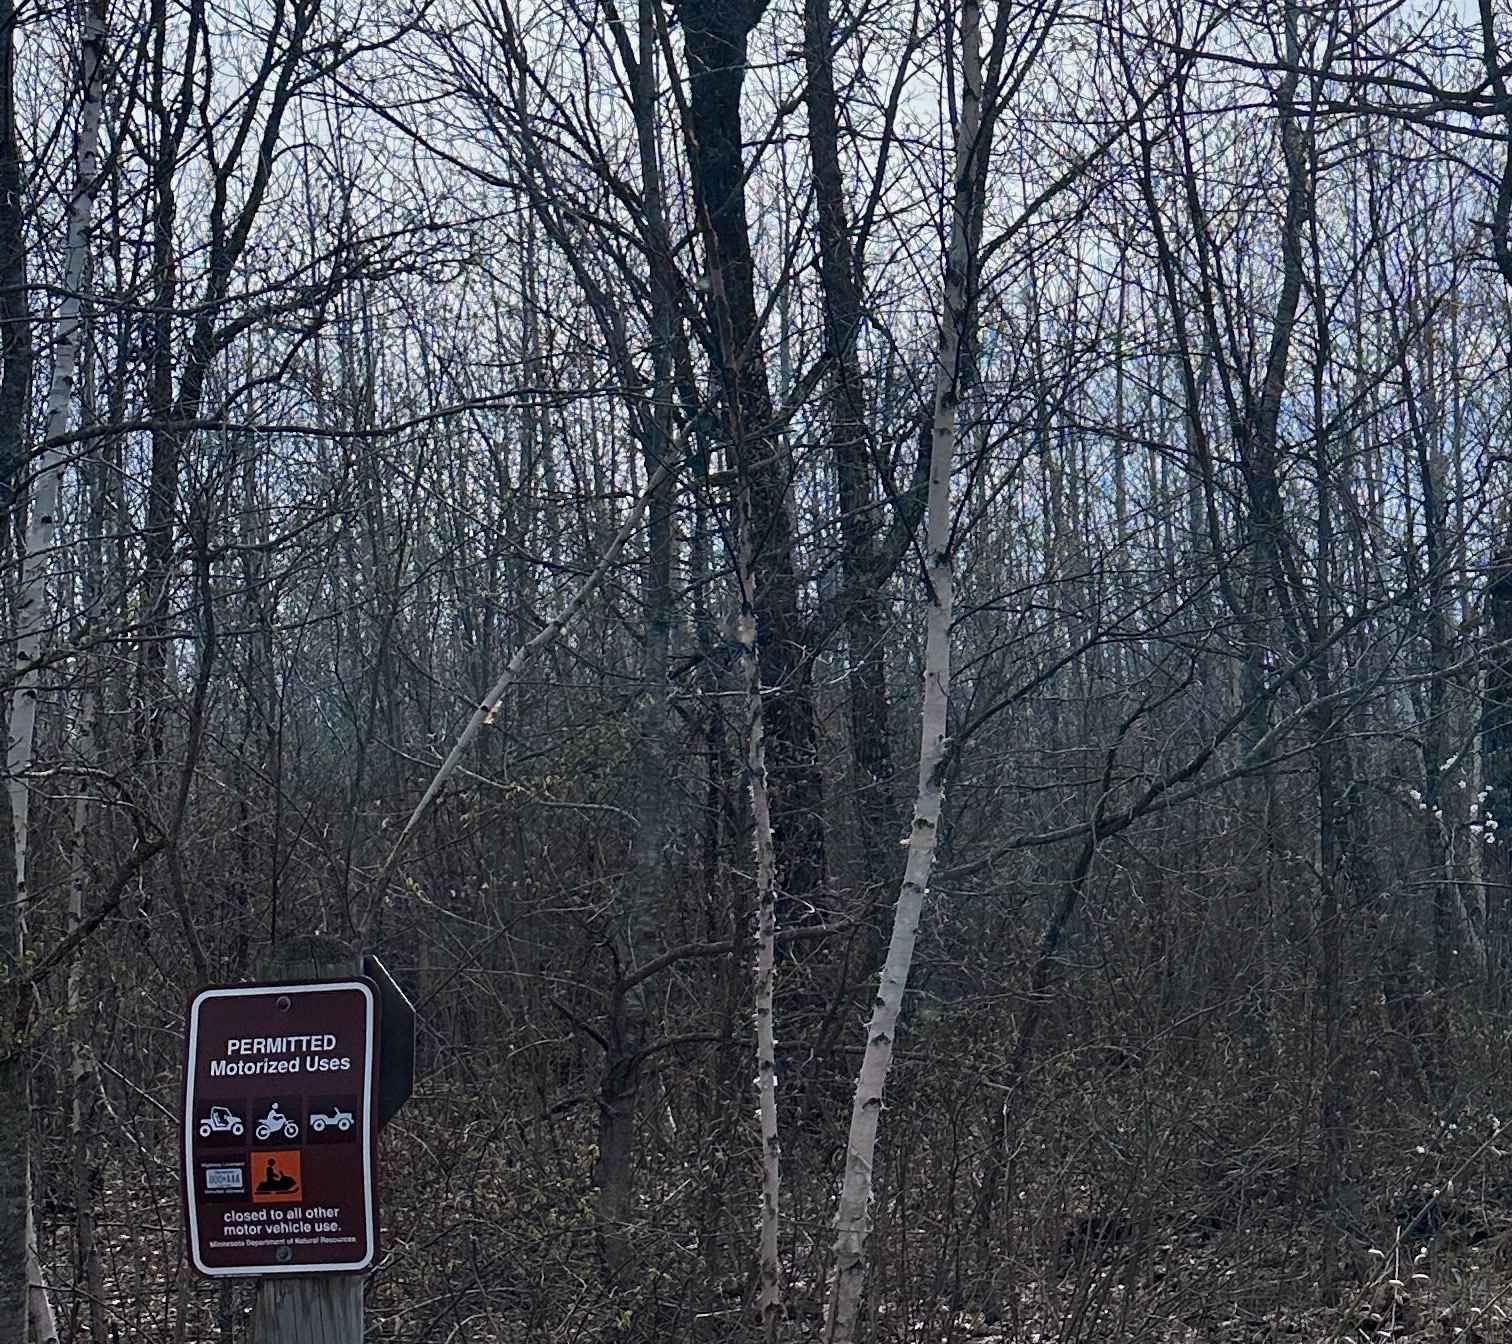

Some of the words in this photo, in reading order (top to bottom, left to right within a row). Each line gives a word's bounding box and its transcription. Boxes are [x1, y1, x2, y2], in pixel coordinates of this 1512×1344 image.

[227, 1034, 336, 1056] PERMITTED
[210, 1057, 300, 1076] Motorized
[306, 1056, 351, 1071] Uses
[224, 1208, 267, 1222] closed
[270, 1209, 283, 1220] to
[286, 1207, 302, 1220] all
[305, 1206, 340, 1219] other
[224, 1224, 262, 1236] motor
[265, 1221, 311, 1234] vehicle
[314, 1221, 342, 1232] use.
[246, 1238, 286, 1247] Department
